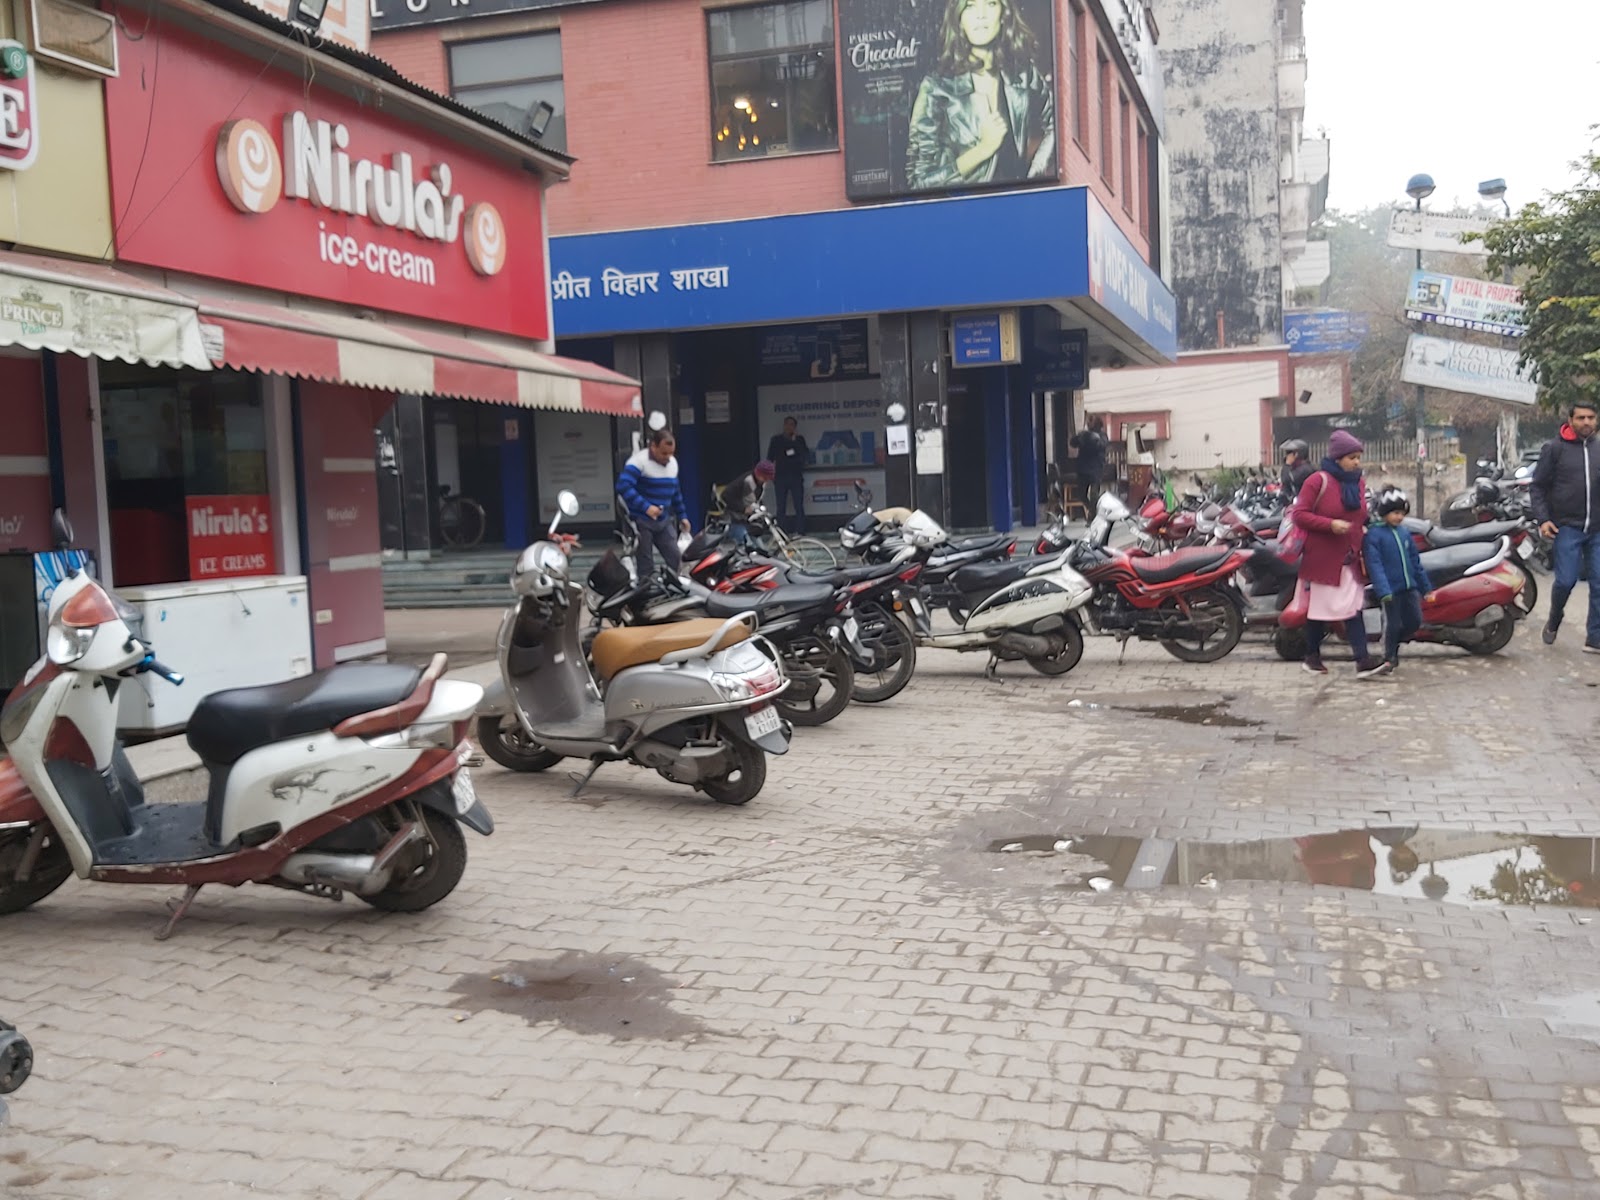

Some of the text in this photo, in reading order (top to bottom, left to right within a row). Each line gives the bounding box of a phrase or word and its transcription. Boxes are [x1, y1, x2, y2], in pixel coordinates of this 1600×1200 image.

[847, 37, 922, 68] Chocolat
[285, 111, 464, 243] Nirula's
[552, 266, 729, 300] प्रीत विहार शाखा
[2, 302, 64, 327] PRINCE
[773, 401, 840, 413] RECURRING
[191, 506, 269, 537] Nirula's
[199, 553, 266, 574] ICE CREAMS
